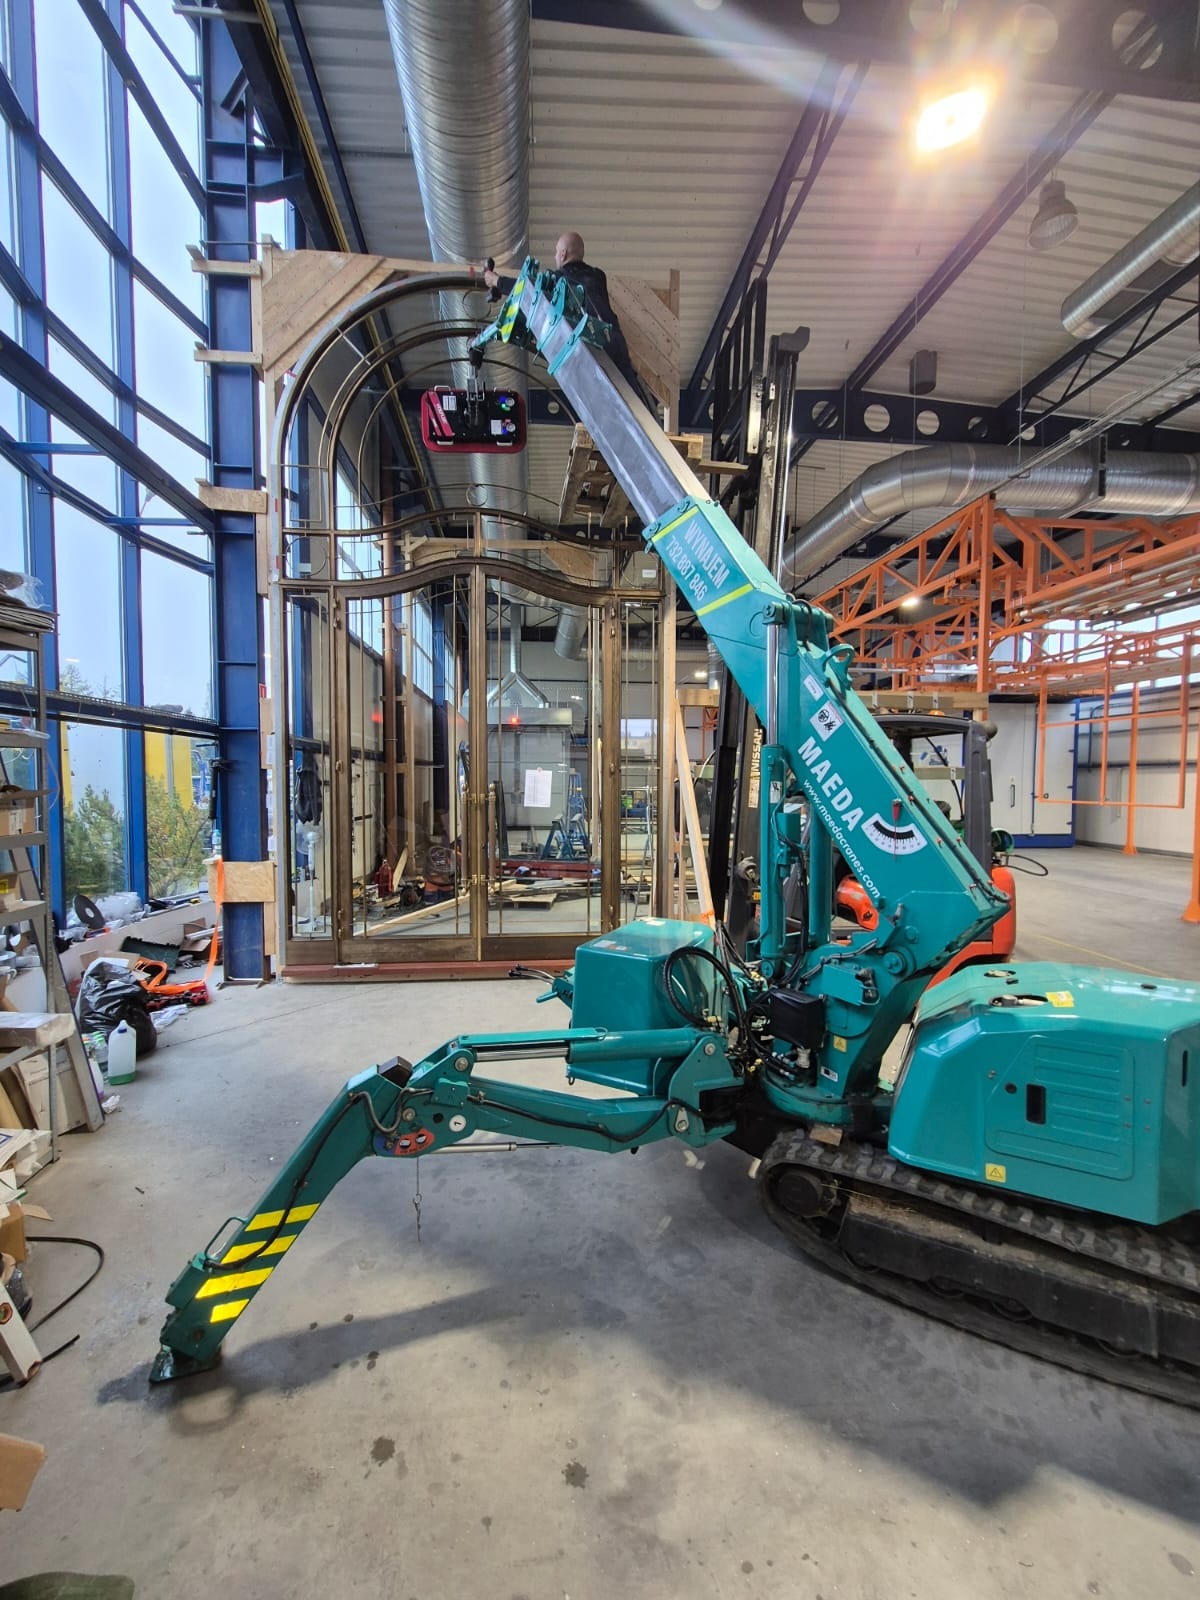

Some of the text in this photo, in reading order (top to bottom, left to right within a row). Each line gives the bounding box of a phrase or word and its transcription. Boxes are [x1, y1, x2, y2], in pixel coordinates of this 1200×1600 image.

[666, 536, 708, 601] 732 887 846
[685, 520, 730, 589] WYNAJEM
[750, 728, 763, 772] NISSAN
[798, 736, 864, 832] MAEDA
[804, 779, 881, 899] www.maedacranes.com
